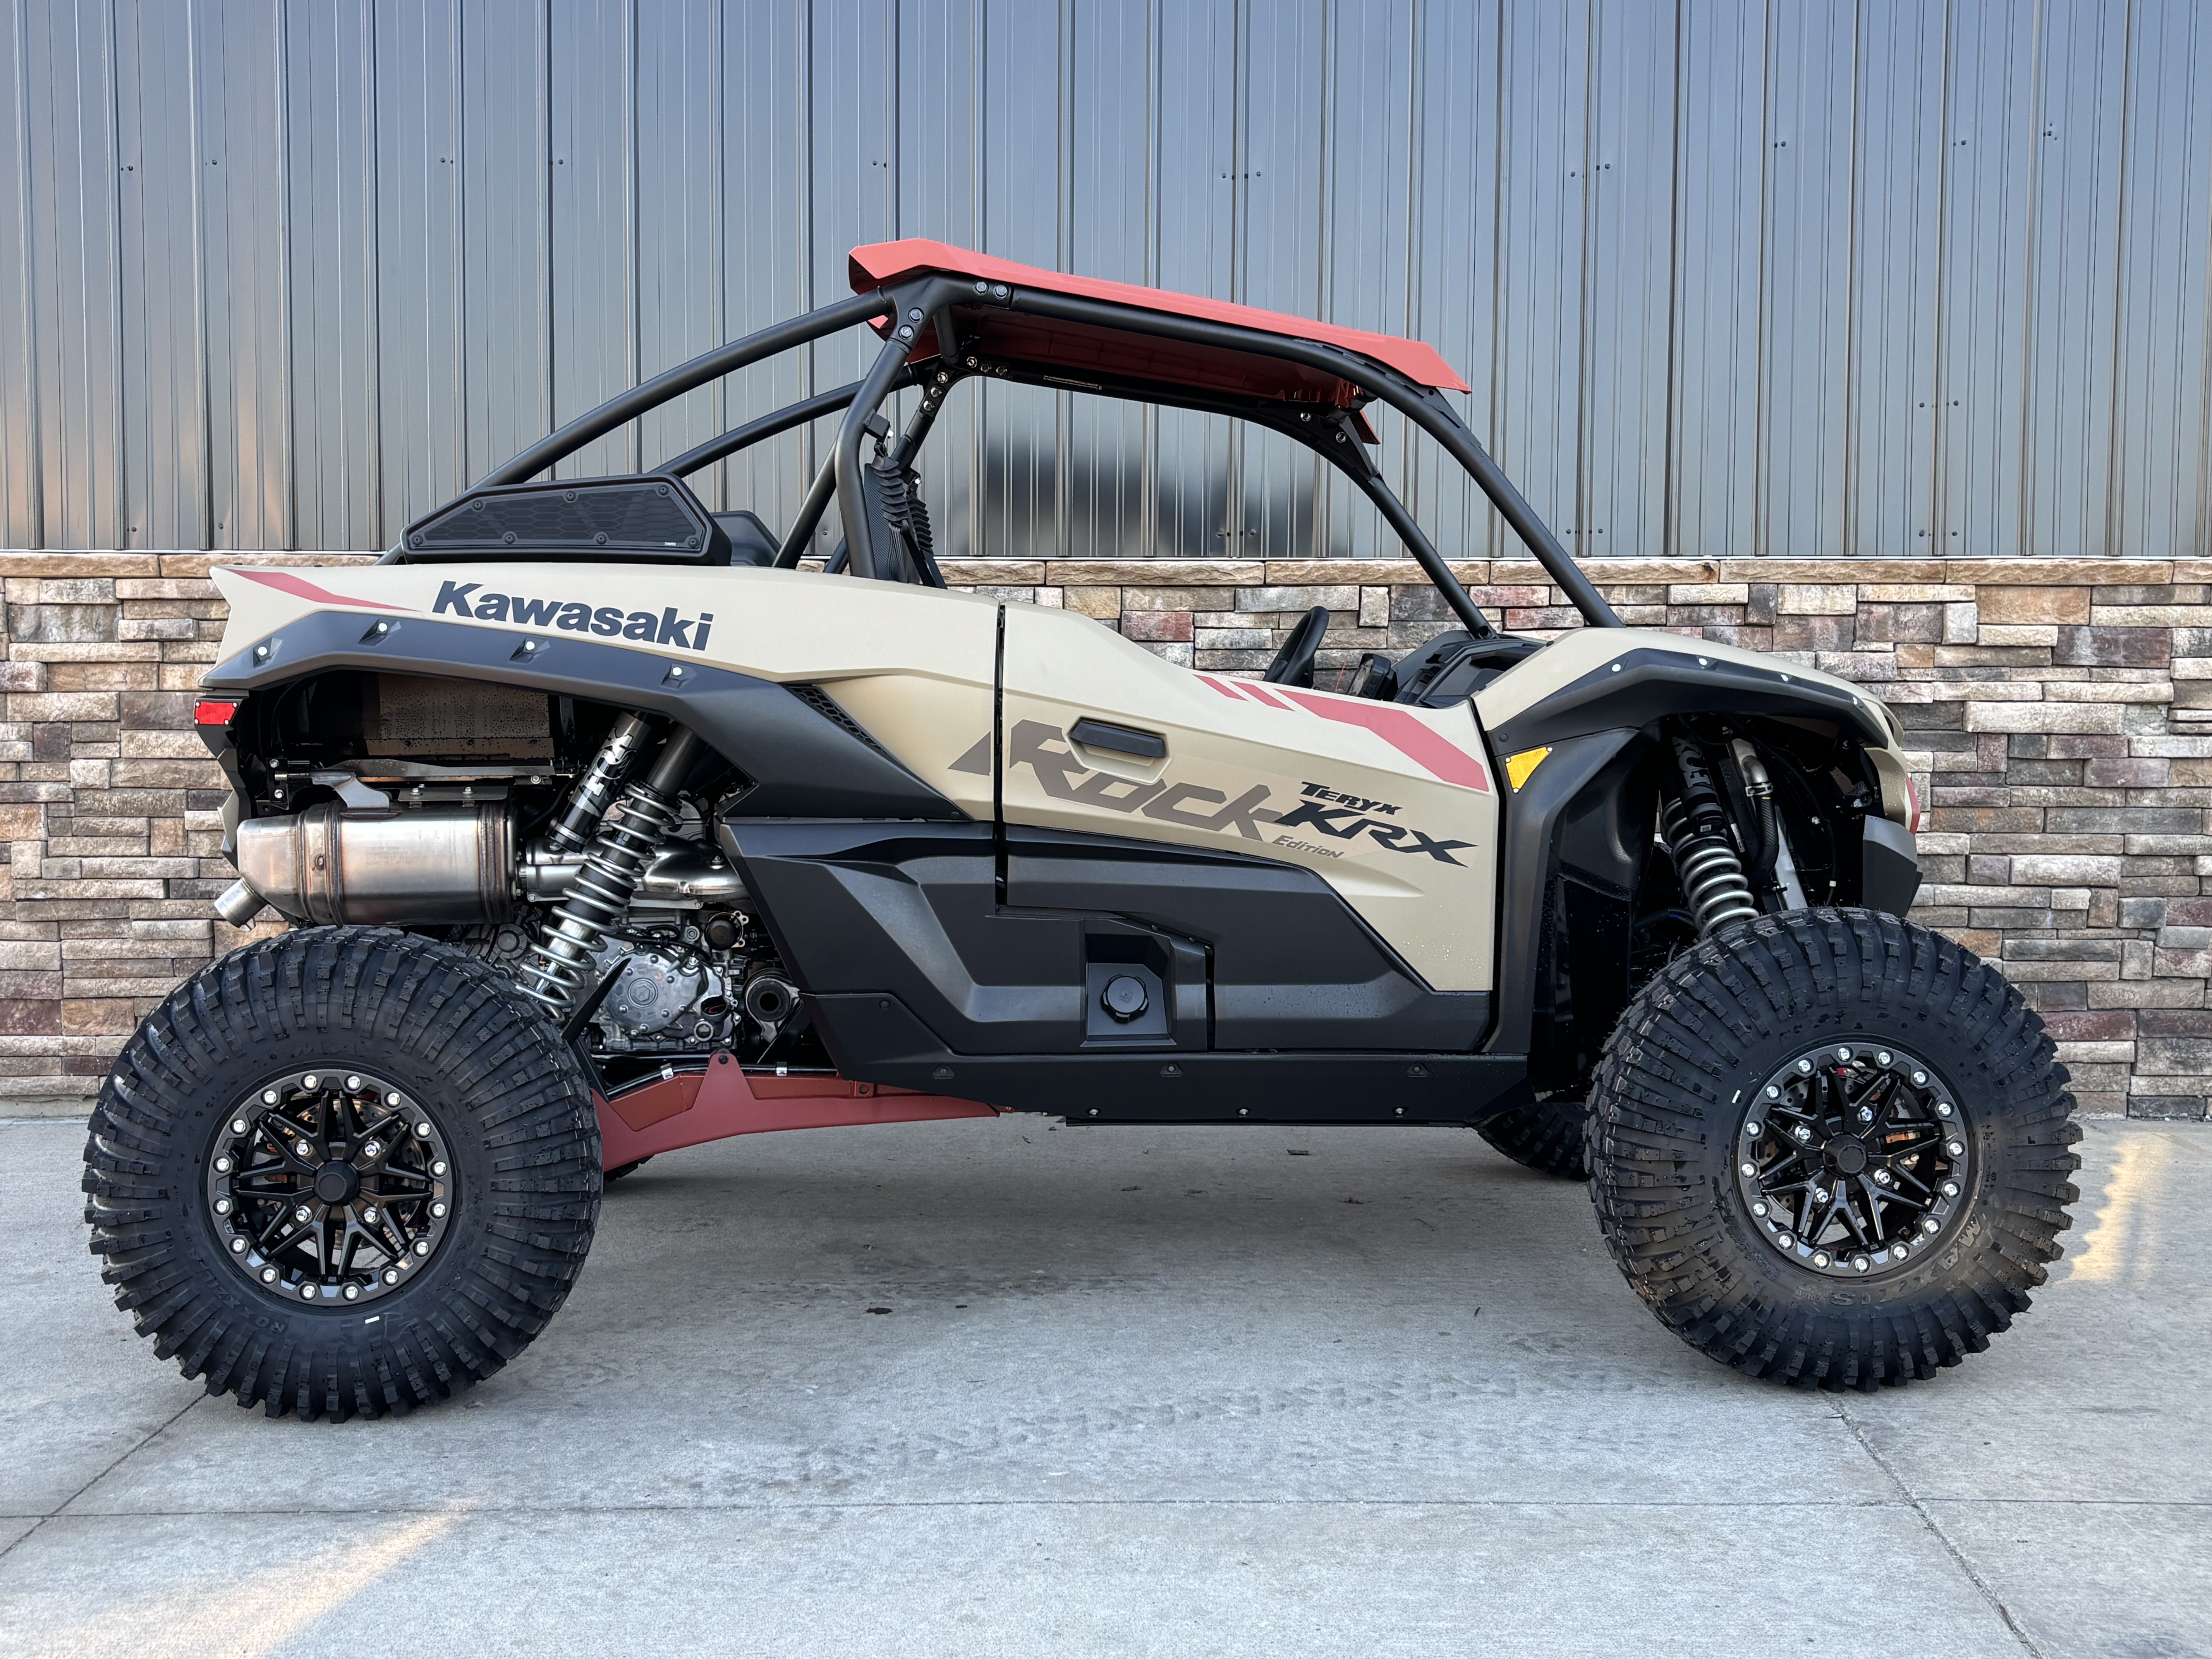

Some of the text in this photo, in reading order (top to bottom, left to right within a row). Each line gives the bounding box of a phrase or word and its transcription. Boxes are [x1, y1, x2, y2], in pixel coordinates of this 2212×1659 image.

[432, 580, 714, 651] Kawasaki
[581, 726, 638, 797] FOX
[1671, 736, 1711, 788] FOX
[1273, 799, 1479, 867] KRX
[1300, 781, 1403, 815] TERYX
[291, 1041, 461, 1119] MAXXIS
[186, 1246, 288, 1334] ROXXZILLA
[1829, 1214, 1981, 1306] MAXXIS
